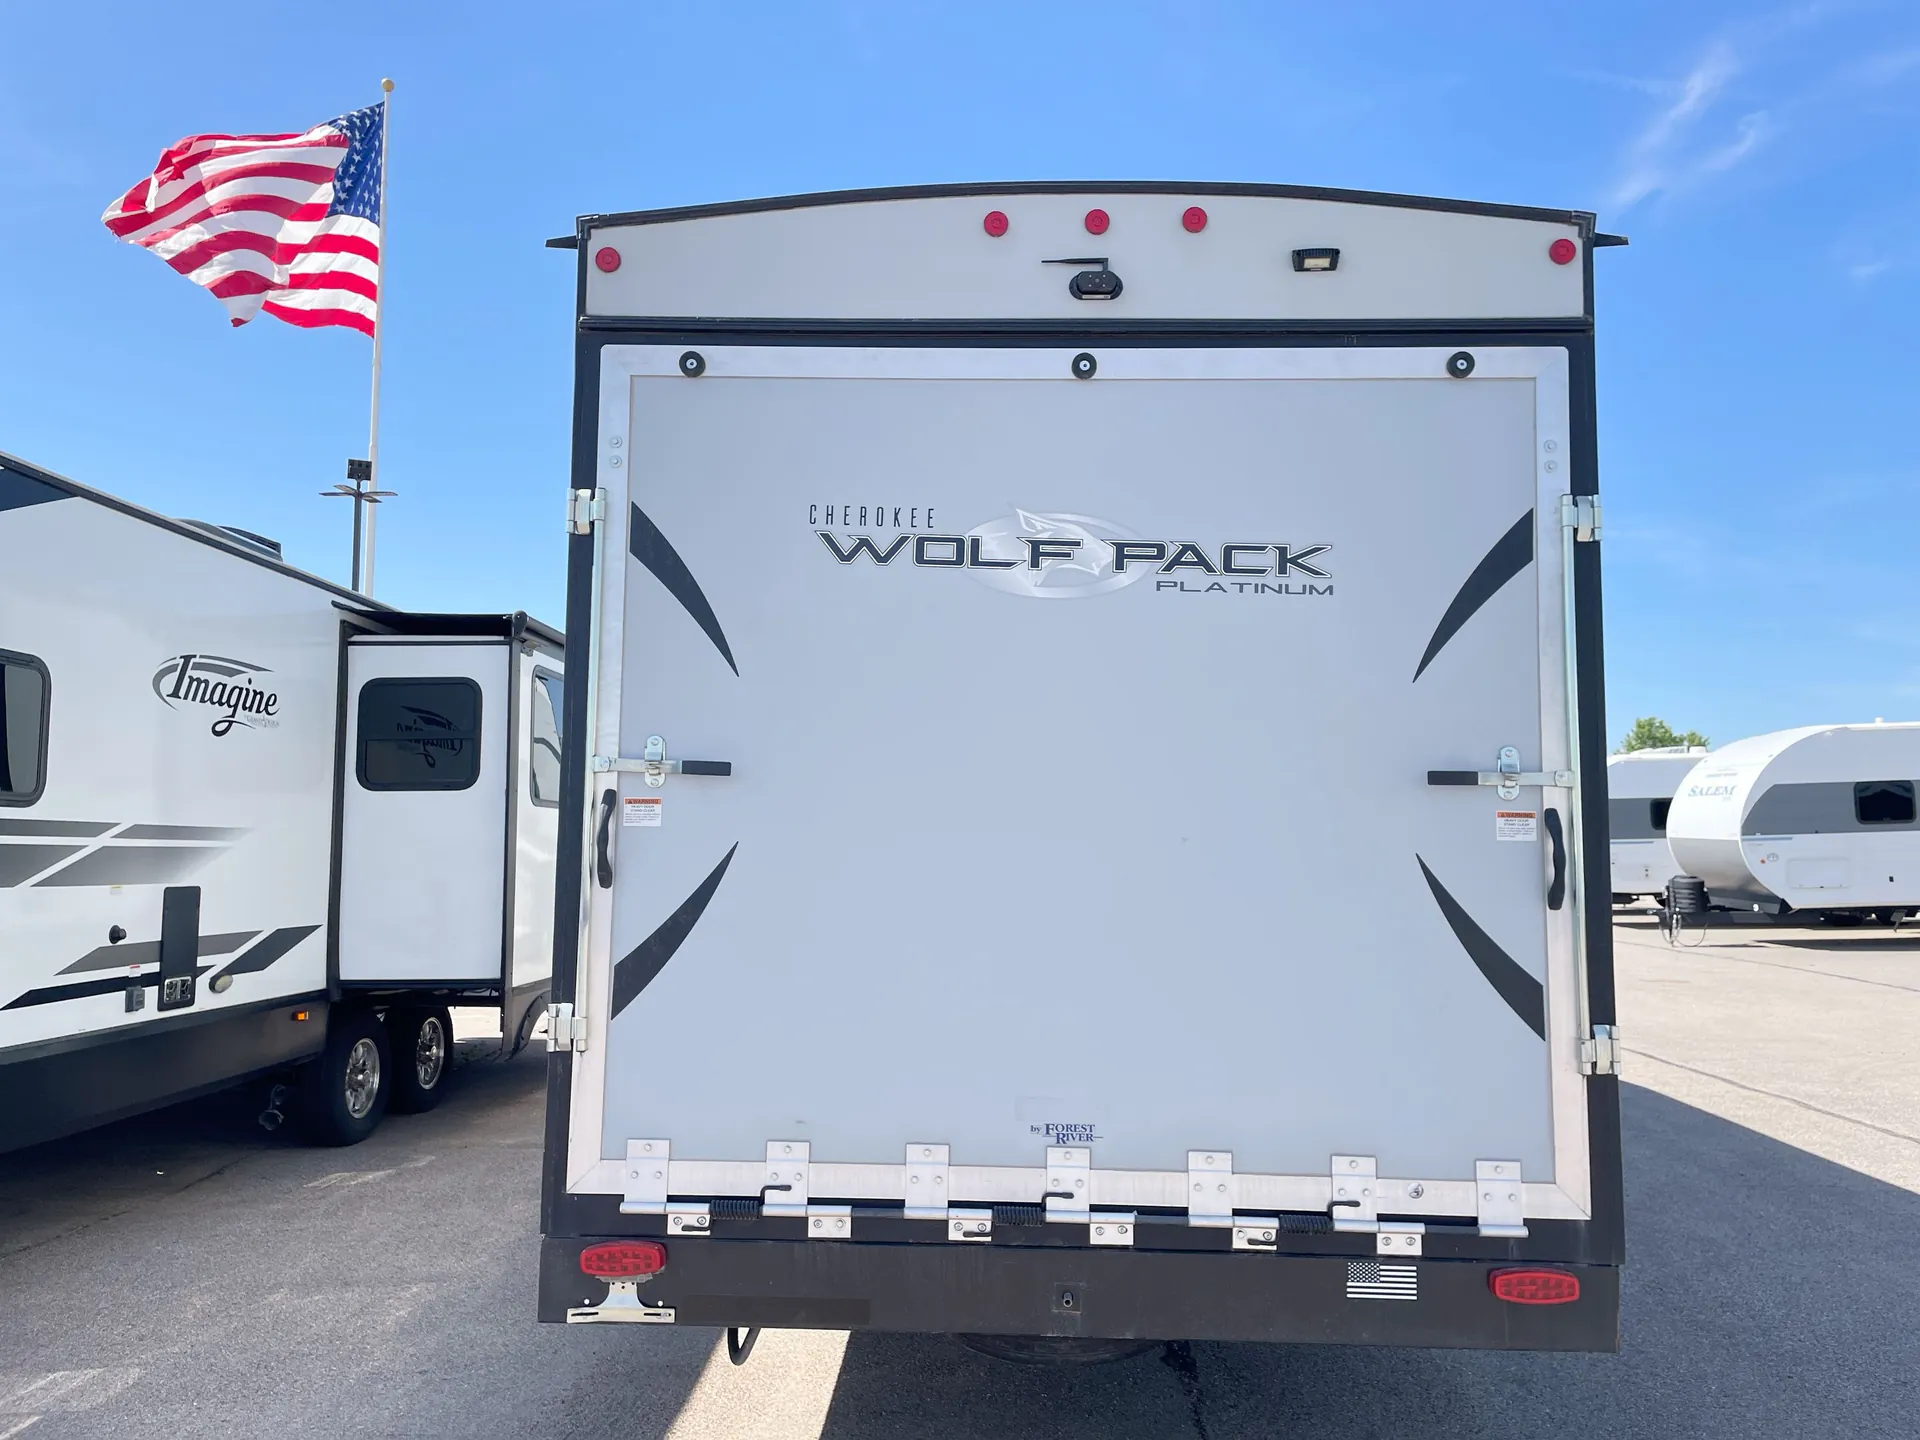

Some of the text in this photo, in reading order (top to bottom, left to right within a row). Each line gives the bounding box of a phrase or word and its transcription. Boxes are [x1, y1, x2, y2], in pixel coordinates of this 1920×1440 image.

[809, 504, 935, 528] CHEROKEE
[814, 530, 1333, 579] WOLF PACK
[1156, 580, 1334, 596] PLATINUM
[166, 654, 280, 737] Imagine
[1688, 785, 1738, 797] SALEM
[1030, 1123, 1096, 1135] by FOREST
[1055, 1132, 1094, 1145] RIVER
